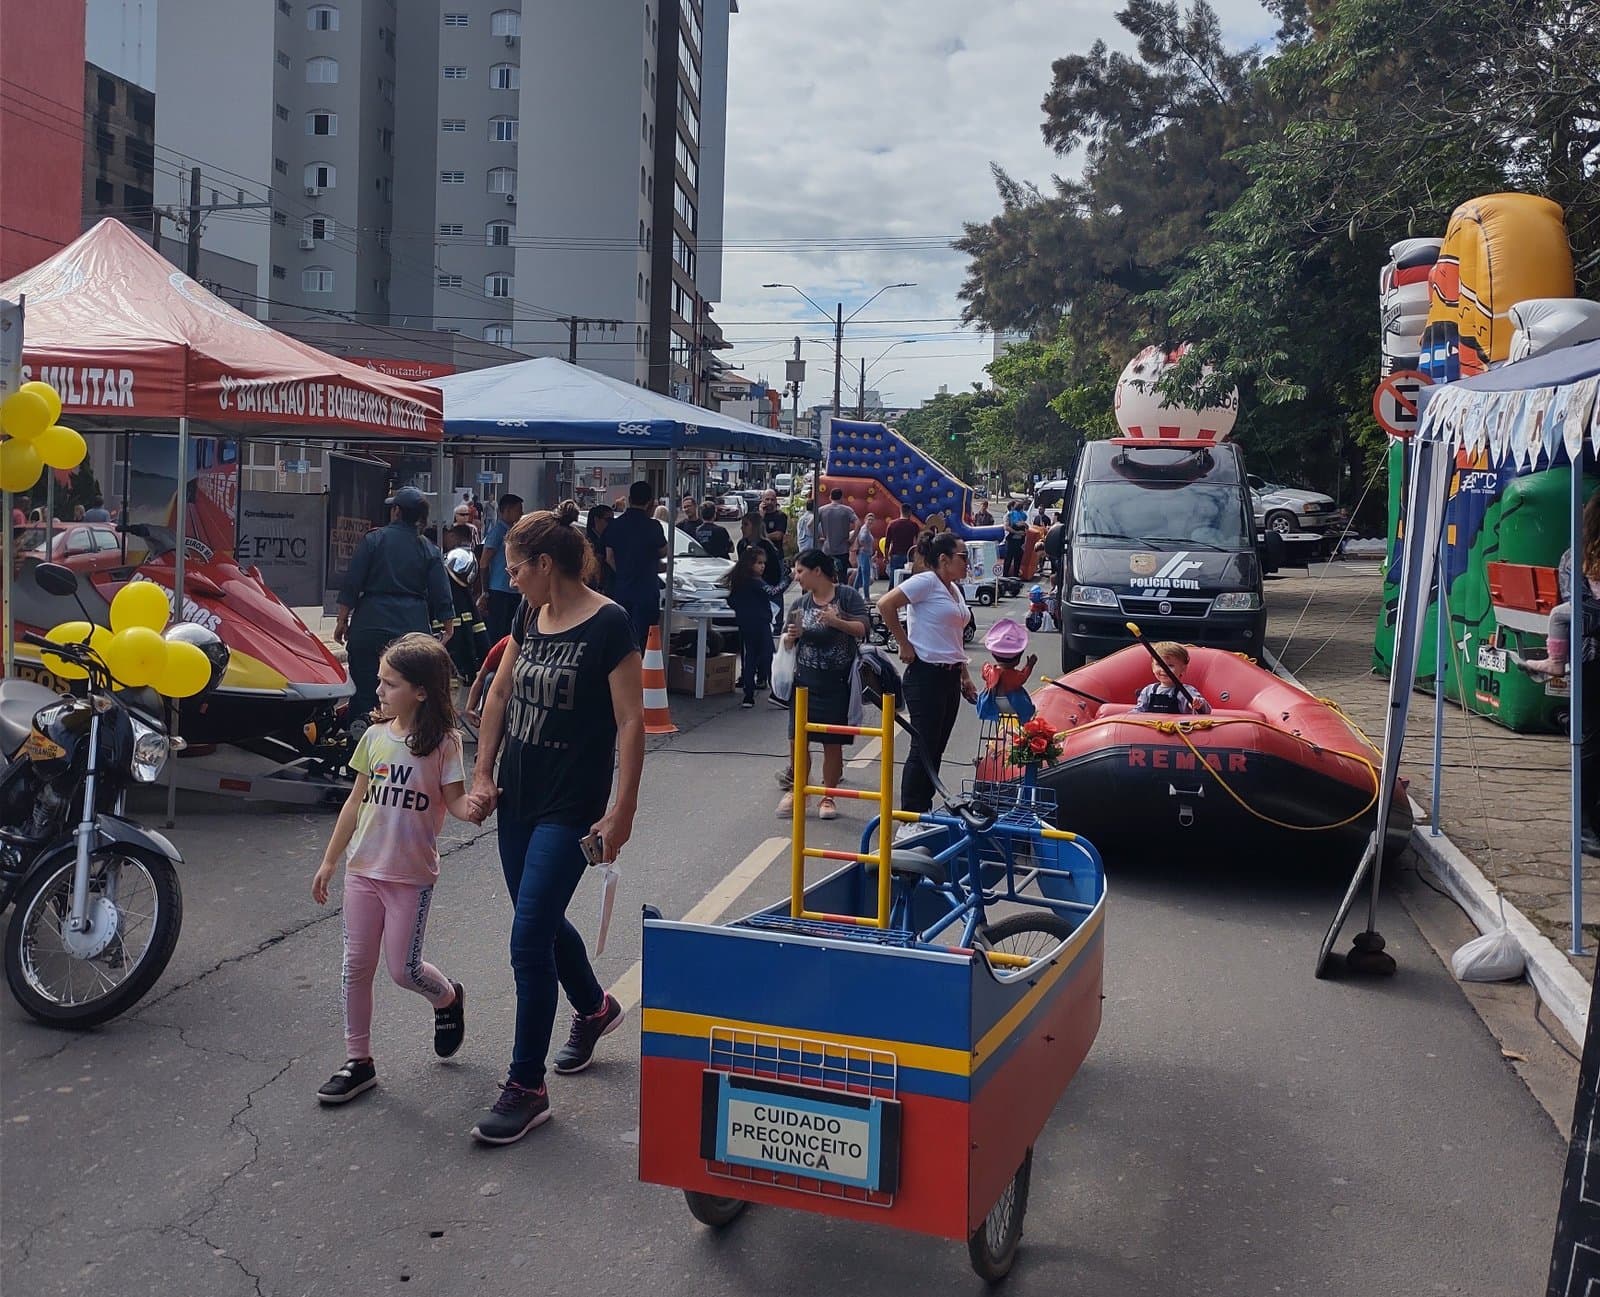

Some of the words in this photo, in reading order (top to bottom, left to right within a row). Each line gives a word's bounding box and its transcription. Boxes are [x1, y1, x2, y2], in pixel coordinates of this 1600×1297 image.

[379, 363, 433, 377] Santander
[309, 383, 324, 417] DE
[618, 421, 652, 436] Sesc
[1130, 576, 1171, 588] POLÍCIA
[1172, 578, 1200, 590] CIVIL
[1127, 748, 1248, 774] REMAR
[753, 1105, 841, 1135] CUIDADO
[731, 1122, 862, 1158] PRECONCEITO
[760, 1144, 830, 1171] NUNCA
